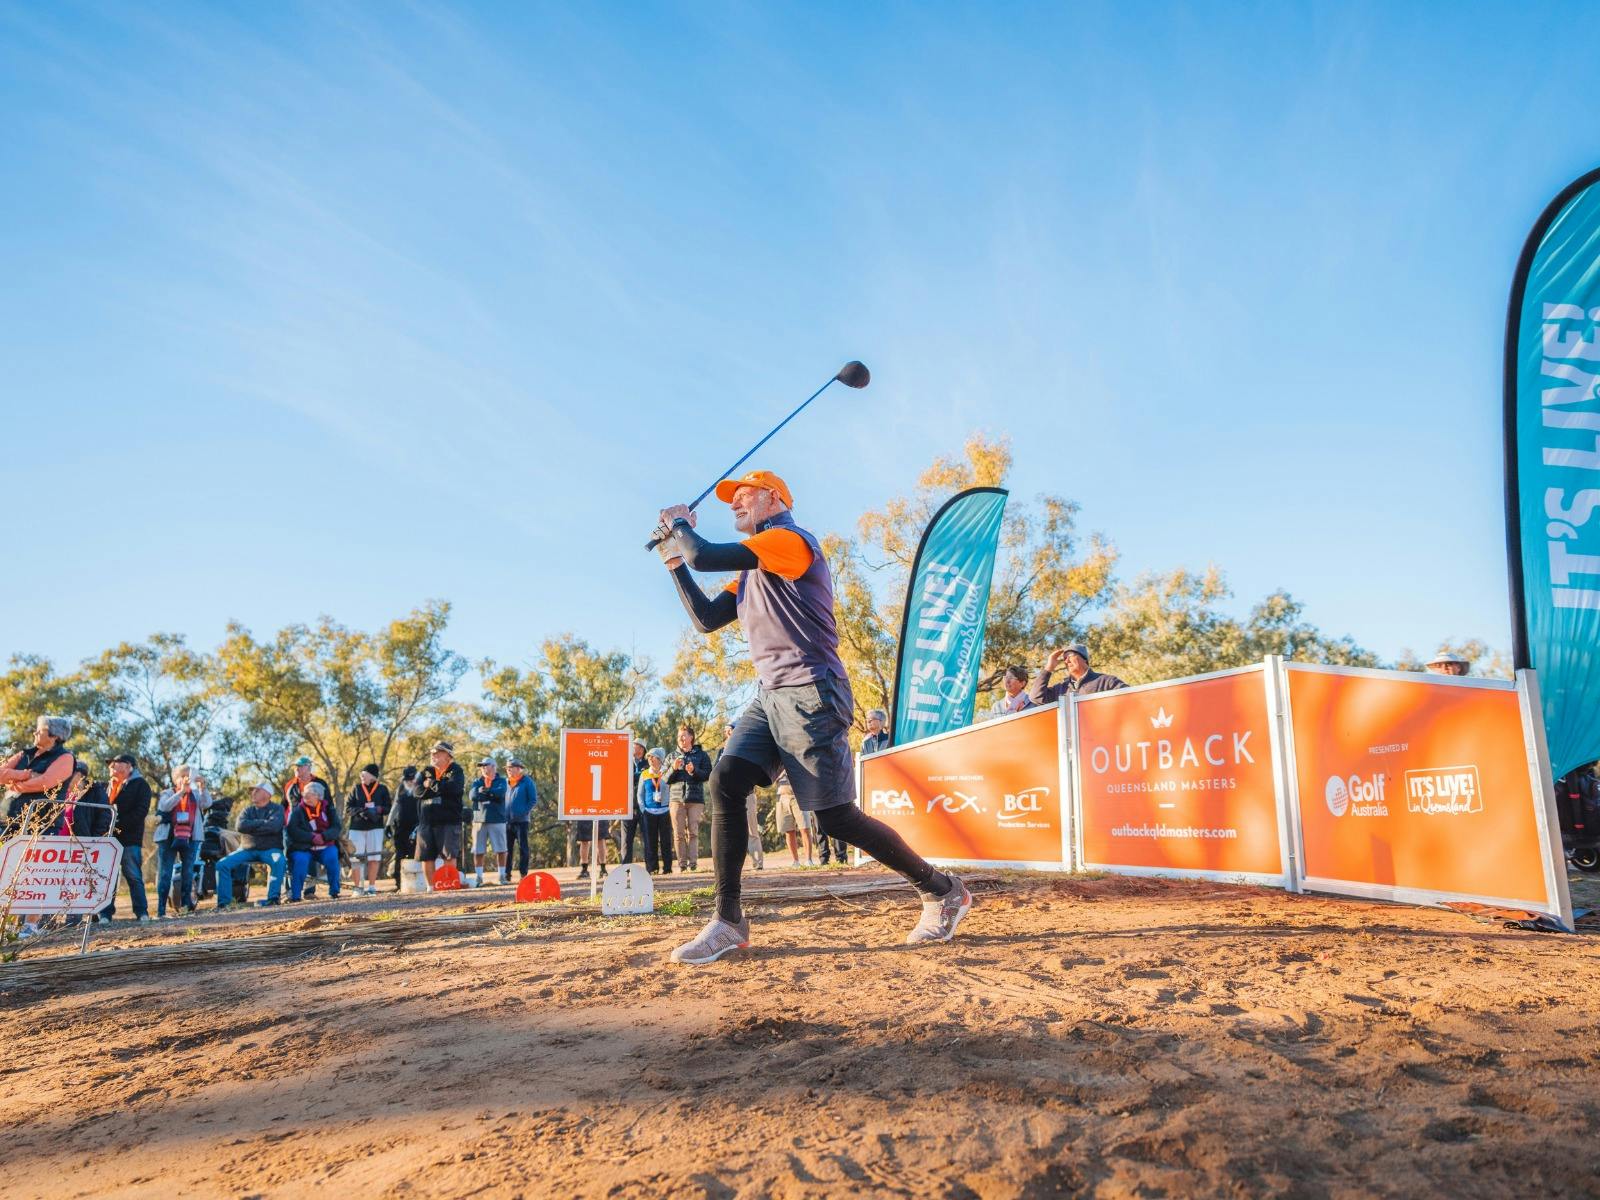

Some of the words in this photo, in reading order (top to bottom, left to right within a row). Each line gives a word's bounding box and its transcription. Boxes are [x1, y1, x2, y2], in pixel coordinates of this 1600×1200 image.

[1540, 302, 1600, 470] LIVE!
[1544, 487, 1600, 610] IT'S
[915, 561, 960, 653] LIVE!
[938, 576, 983, 704] Queensland
[907, 659, 945, 723] IT'S
[1091, 730, 1255, 774] OUTBACK
[1368, 744, 1400, 754] PRESENTED
[1401, 743, 1408, 752] BY
[590, 765, 602, 801] 1
[1107, 781, 1176, 794] QUEENSLAND
[1181, 777, 1236, 791] MASTERS
[1348, 773, 1385, 802] Golf
[1409, 776, 1434, 798] IT'S
[1435, 774, 1475, 797] LIVE!
[871, 789, 915, 809] PGA
[1004, 794, 1042, 812] BCL
[1351, 802, 1388, 817] Australia
[1111, 824, 1237, 840] outbackqldmasters.com
[25, 848, 84, 863] HOLE
[90, 850, 100, 864] 1
[25, 866, 79, 874] Sponsored
[59, 890, 81, 900] Par
[84, 889, 93, 900] 4
